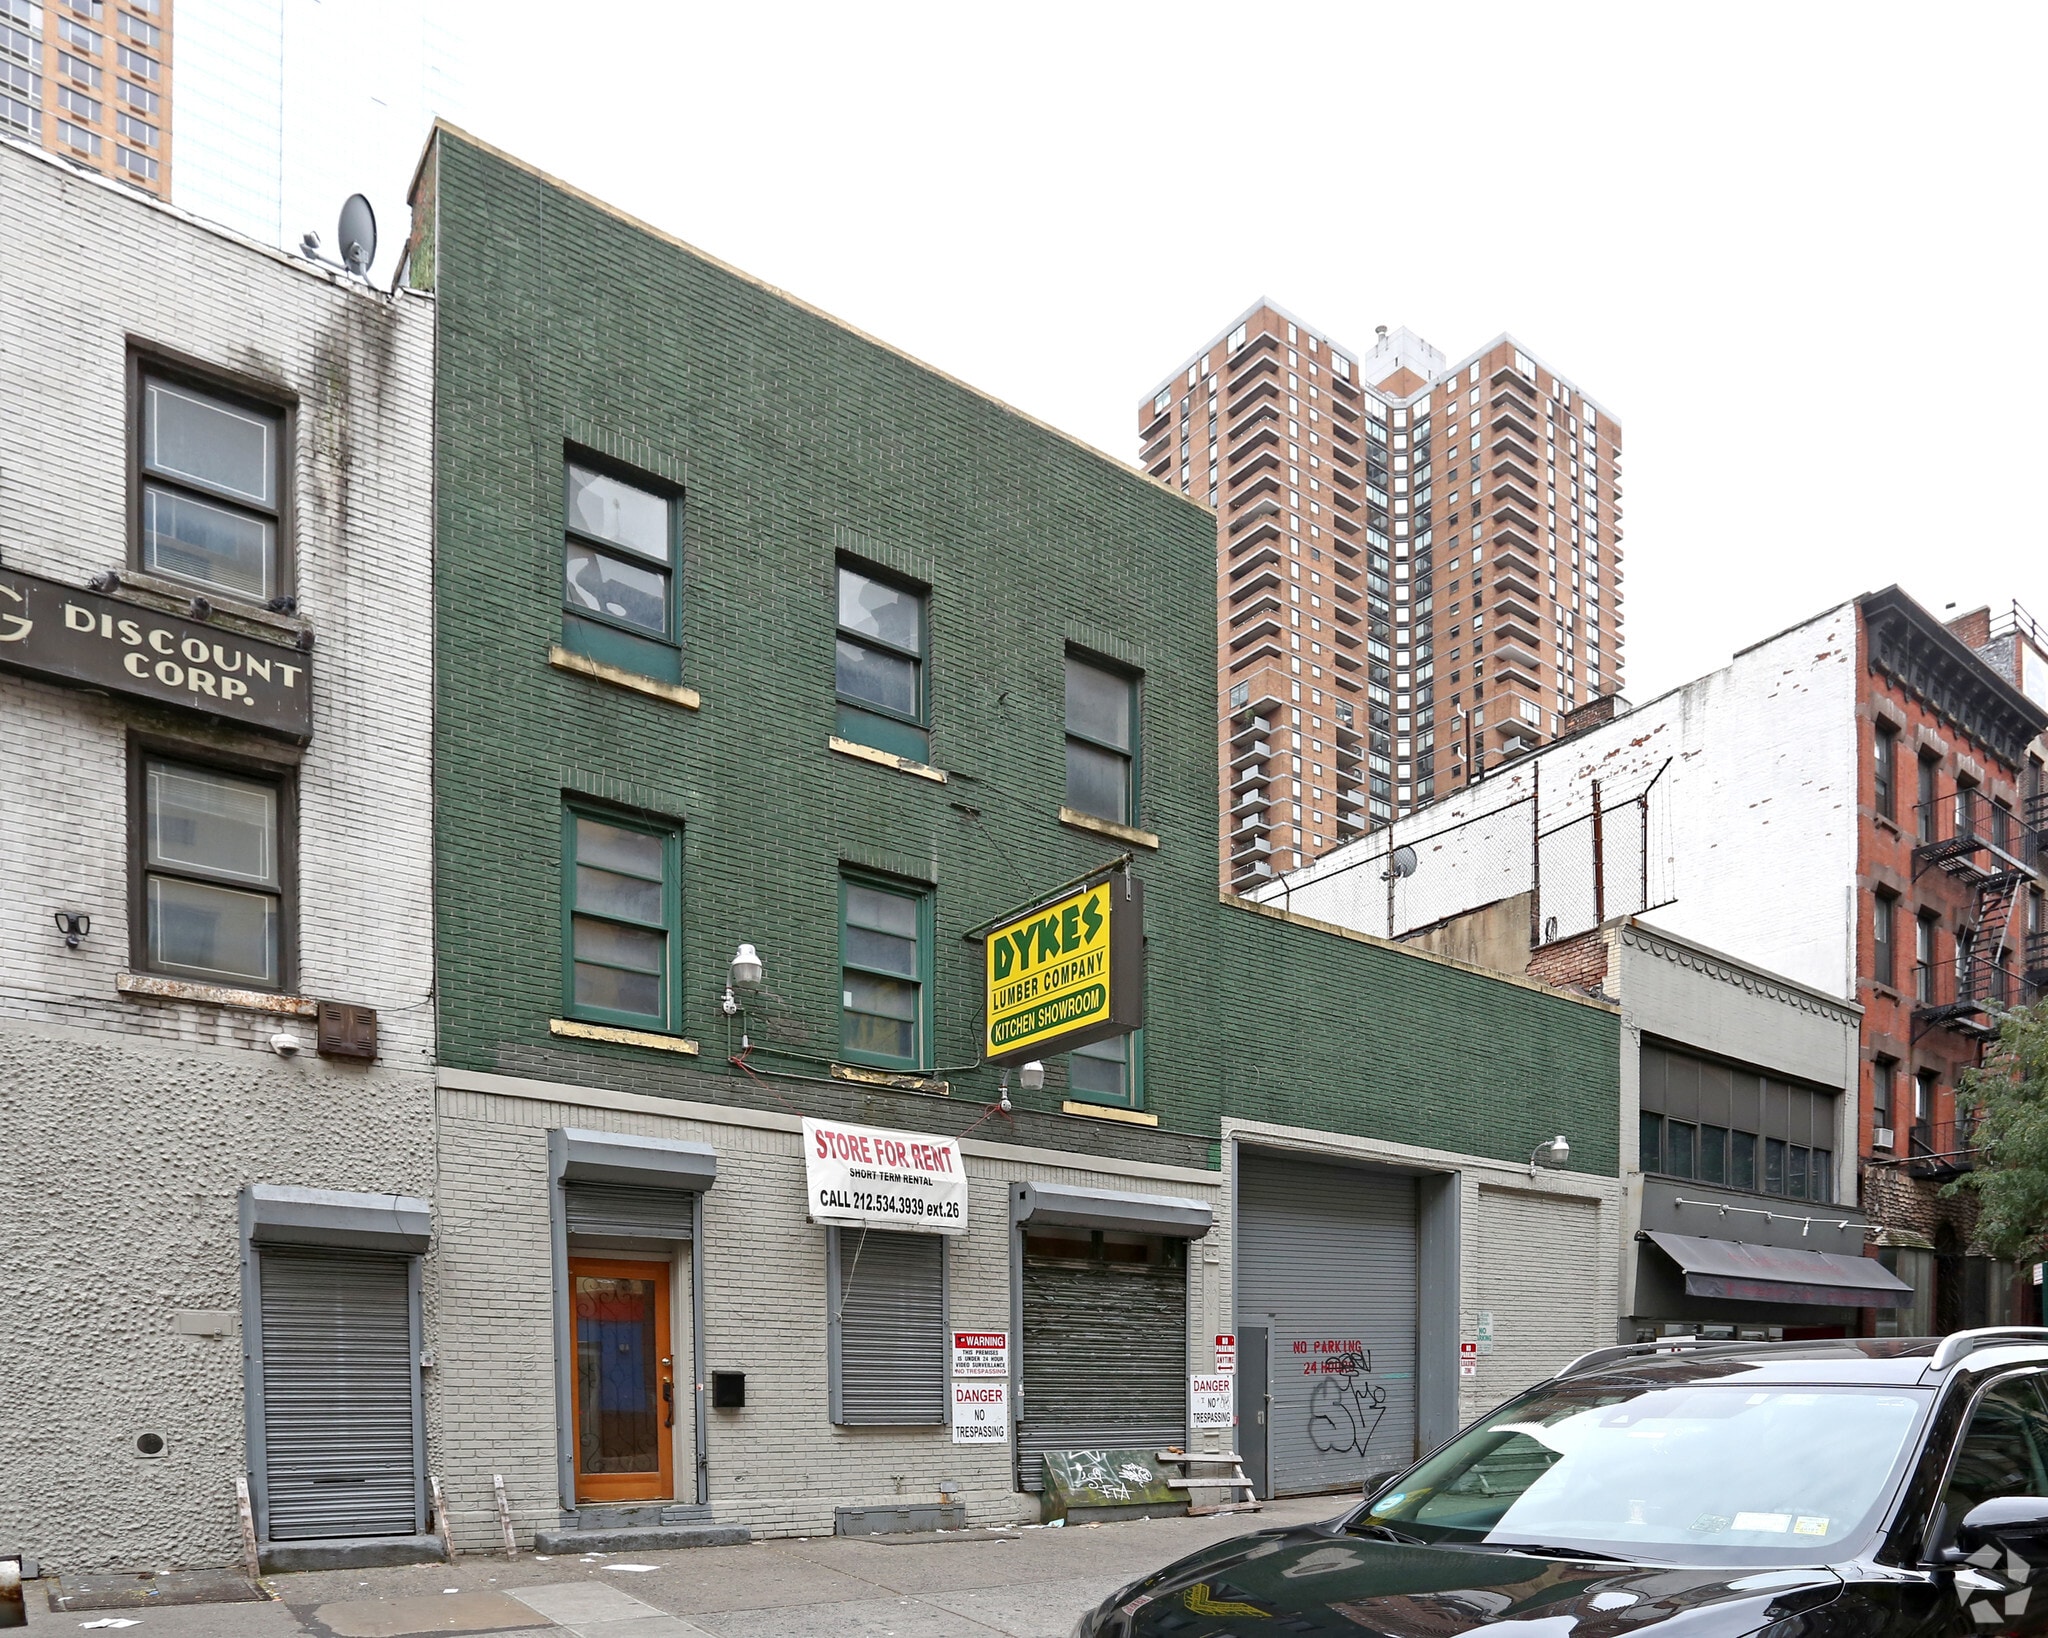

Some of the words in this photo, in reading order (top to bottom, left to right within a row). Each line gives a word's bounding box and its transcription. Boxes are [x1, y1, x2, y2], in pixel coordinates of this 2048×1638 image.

[65, 603, 303, 688] DISCOUNT
[124, 652, 255, 706] CORP.
[994, 894, 1103, 982] DYKES
[993, 977, 1038, 1010] LUMBER
[1044, 951, 1103, 991] COMPANY
[995, 1013, 1035, 1042] KITCHEN
[1038, 988, 1100, 1028] SHOWROOM
[815, 1129, 872, 1163] STORE
[873, 1139, 910, 1168] FOR
[911, 1143, 953, 1173] RENT
[849, 1168, 877, 1180] SHORT
[880, 1172, 901, 1183] TERM
[903, 1175, 933, 1186] RENTAL
[820, 1189, 850, 1208] CALL
[853, 1192, 924, 1215] 212.534.3939
[926, 1201, 960, 1218] ext.26
[965, 1336, 1004, 1346] WARNING
[1293, 1341, 1307, 1354] NO
[1314, 1340, 1362, 1353] PARKING
[1303, 1361, 1317, 1374] 24
[1193, 1380, 1230, 1391] DANGER
[956, 1389, 1003, 1402] DANGER
[1207, 1397, 1216, 1408] NO
[974, 1409, 985, 1421] NO
[1193, 1412, 1230, 1423] TRESPASSING
[956, 1426, 1004, 1437] TRESPASSING
